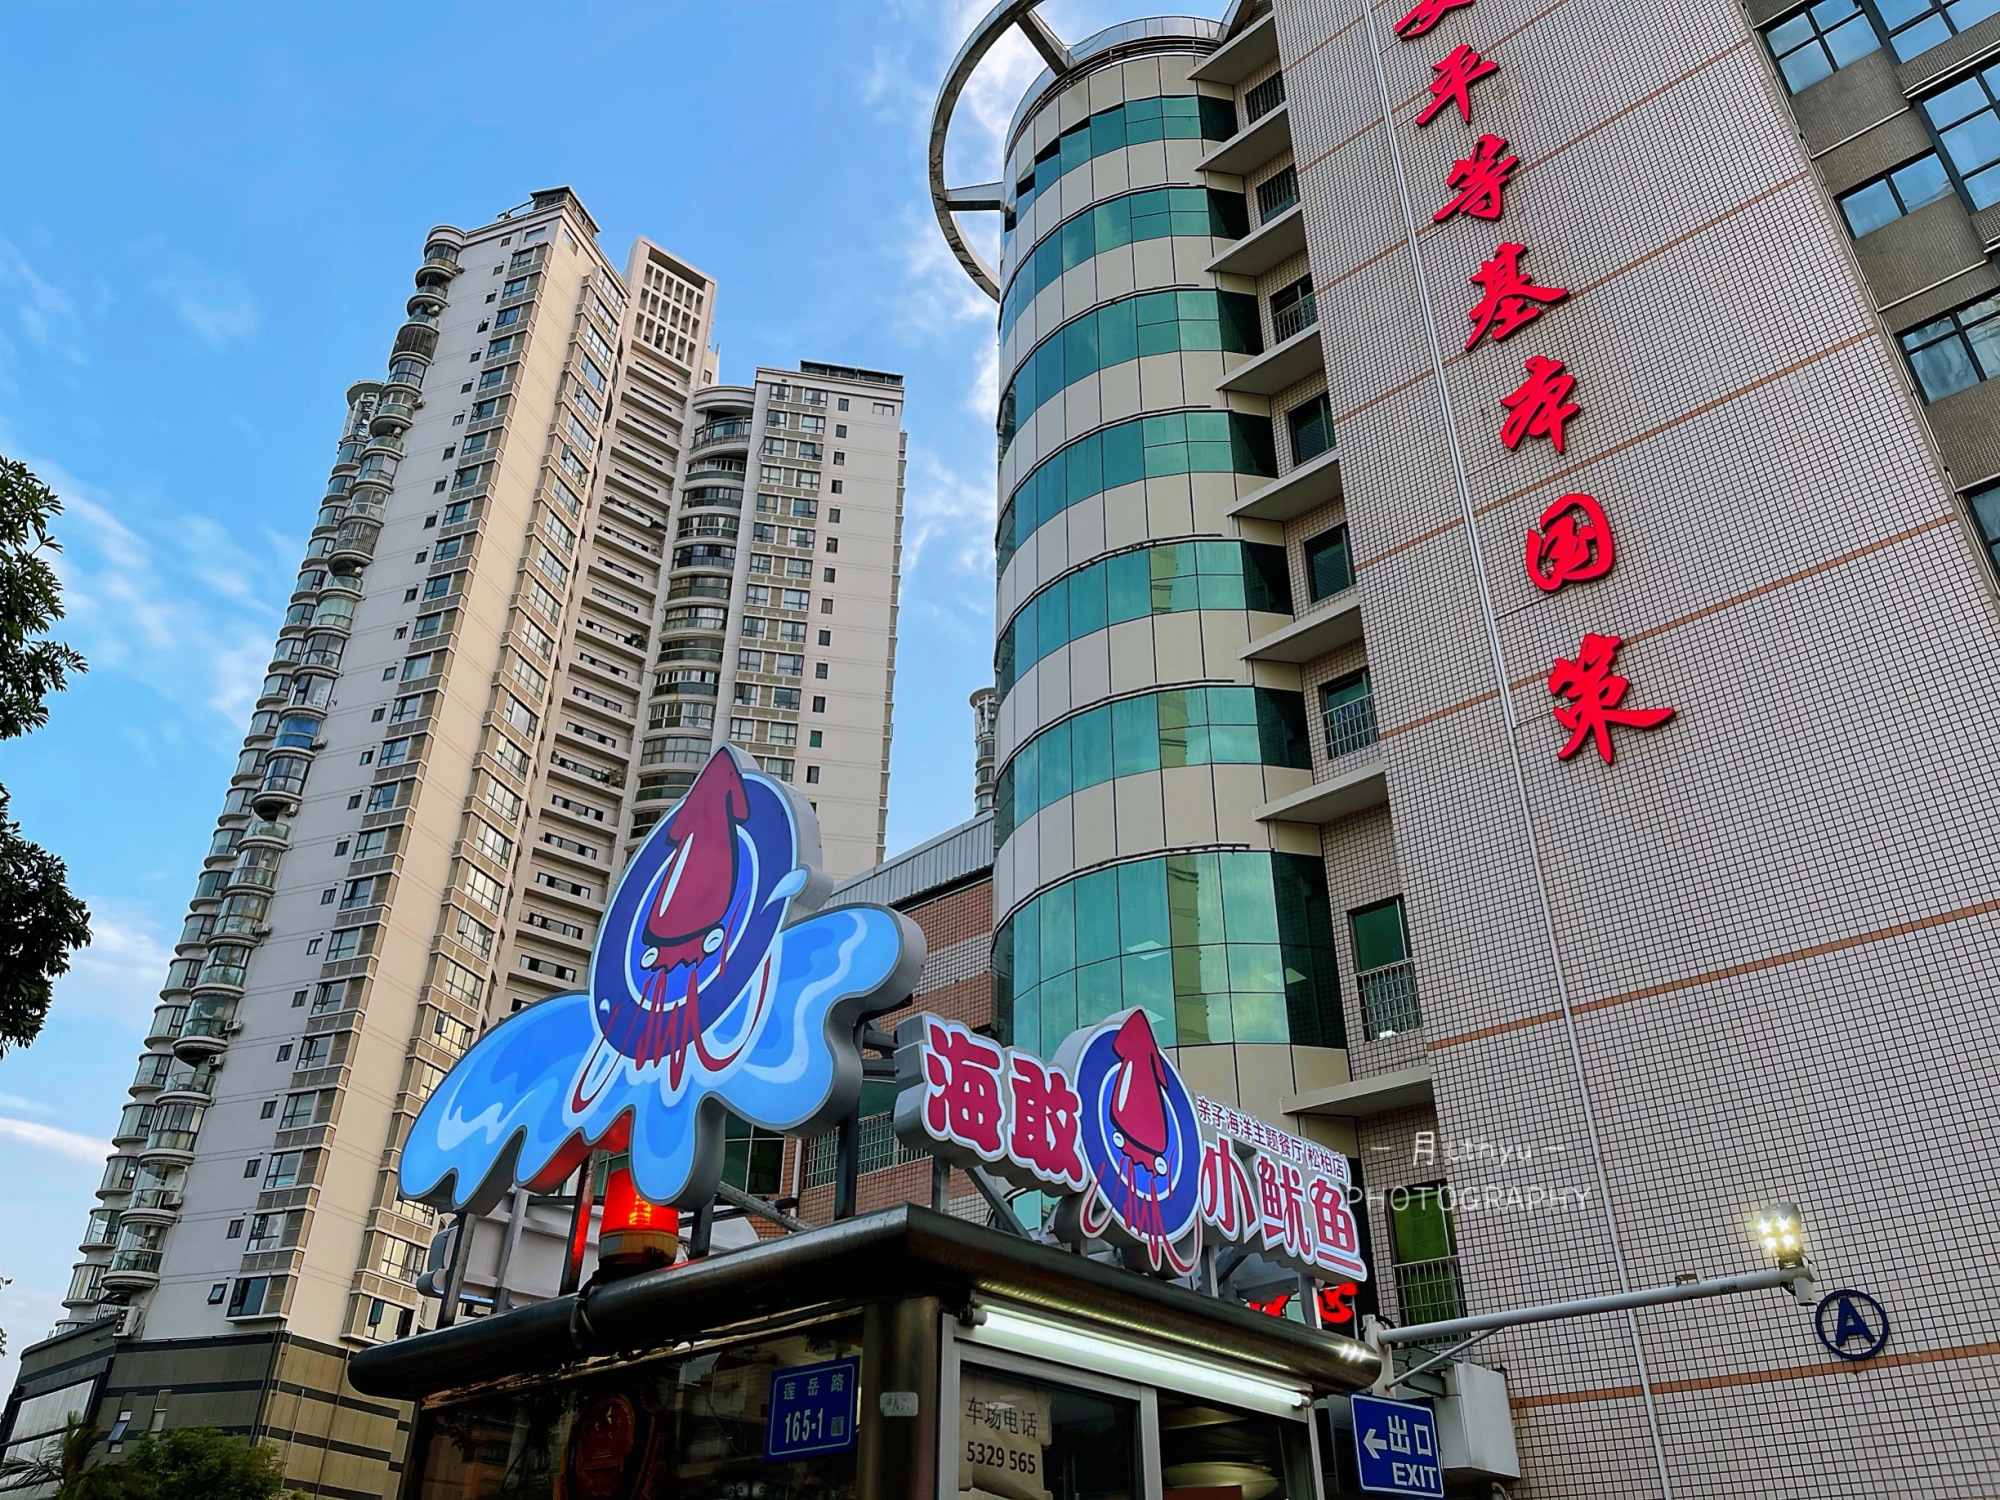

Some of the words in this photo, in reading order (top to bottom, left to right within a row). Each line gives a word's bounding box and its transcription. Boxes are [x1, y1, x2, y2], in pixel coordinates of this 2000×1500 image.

[927, 1024, 1083, 1183] 海敢
[1200, 1137, 1363, 1273] 小鱿鱼
[1835, 1297, 1876, 1347] A
[783, 1373, 844, 1401] 莲岳路
[785, 1408, 824, 1443] 165-1
[965, 1397, 1038, 1439] 车场电话
[1387, 1415, 1432, 1456] 出口
[966, 1441, 1005, 1469] 5329
[1009, 1449, 1036, 1475] 565
[1392, 1462, 1436, 1489] EXIT
